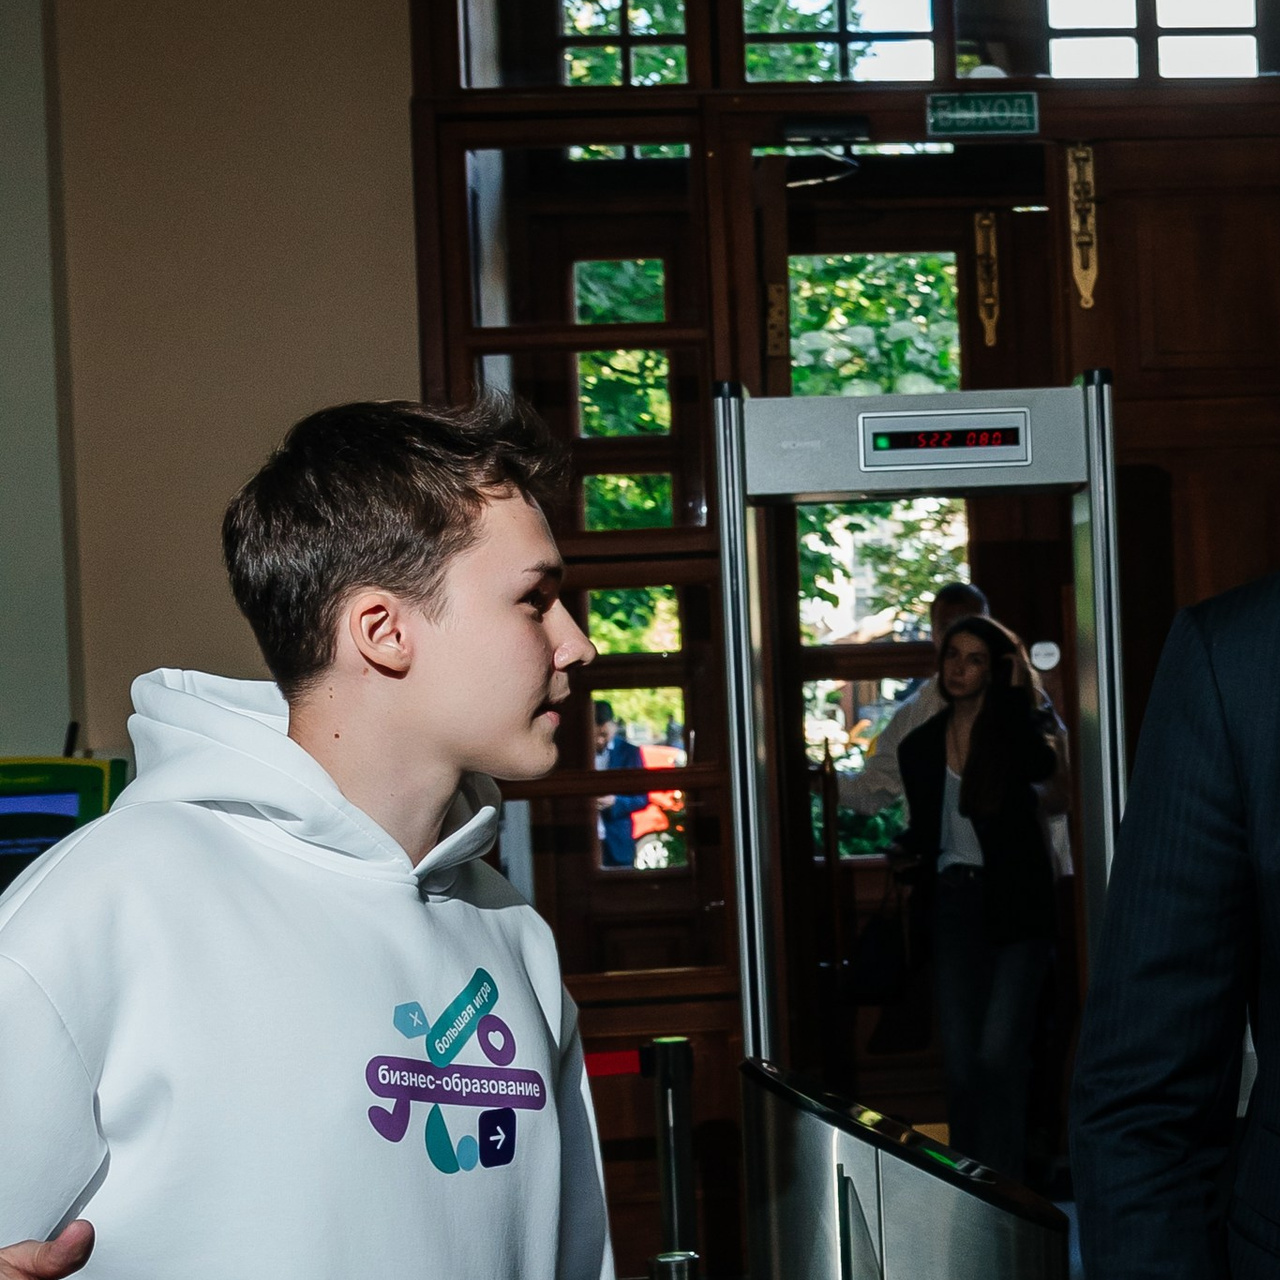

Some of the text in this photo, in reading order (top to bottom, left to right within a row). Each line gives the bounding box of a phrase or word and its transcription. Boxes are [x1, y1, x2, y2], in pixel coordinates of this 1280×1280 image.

[434, 981, 492, 1055] большая игра
[377, 1065, 541, 1098] бизнес-образование
